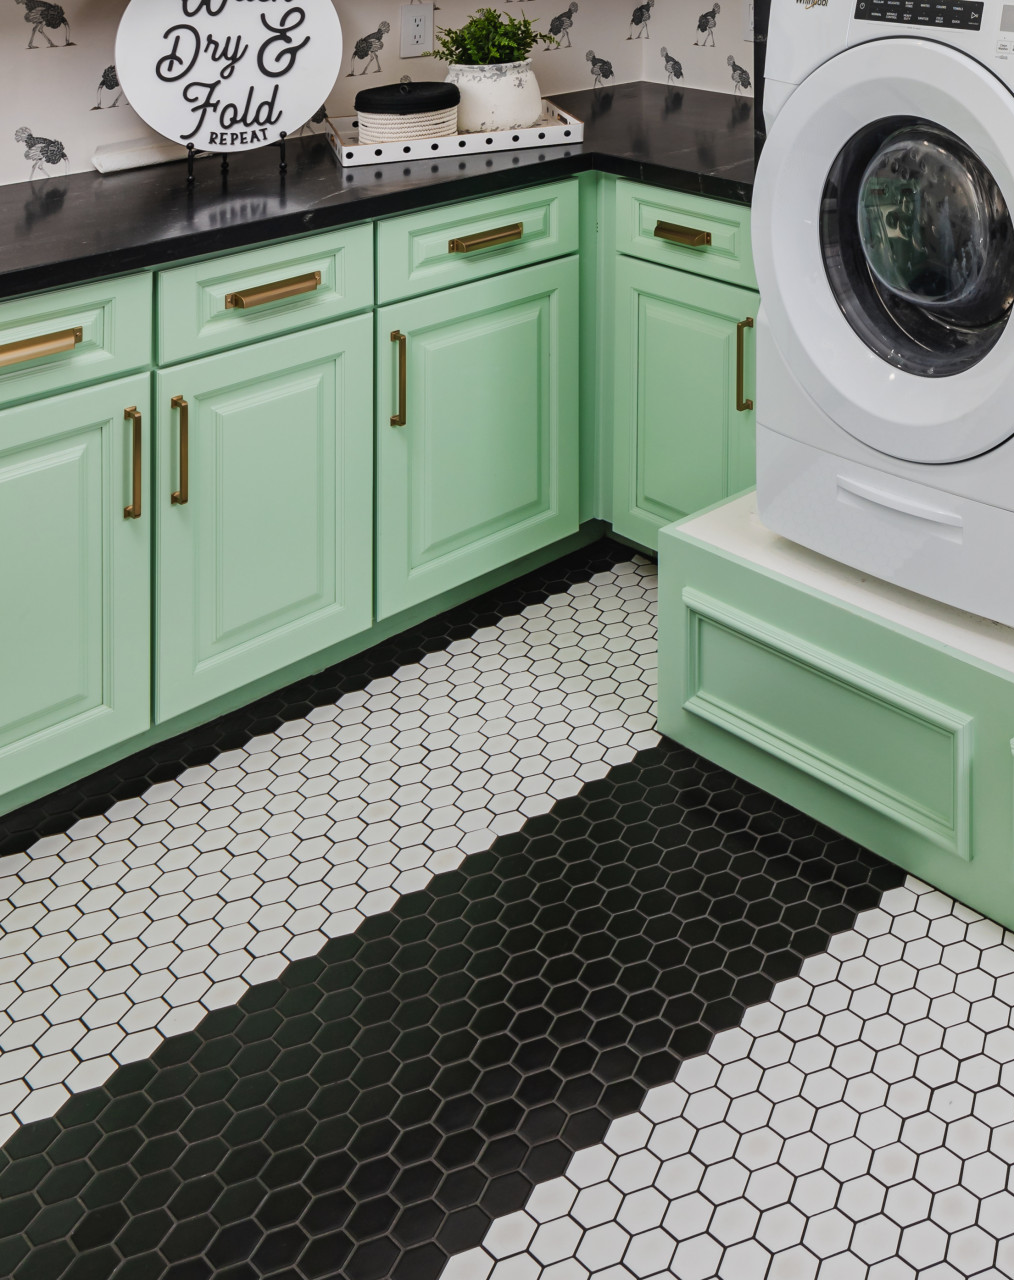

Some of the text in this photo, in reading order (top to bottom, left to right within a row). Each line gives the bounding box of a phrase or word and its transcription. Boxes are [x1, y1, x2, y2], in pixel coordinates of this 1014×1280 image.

[155, 6, 311, 82] Dry &
[179, 79, 283, 140] Fold
[208, 128, 269, 146] REPEAT
